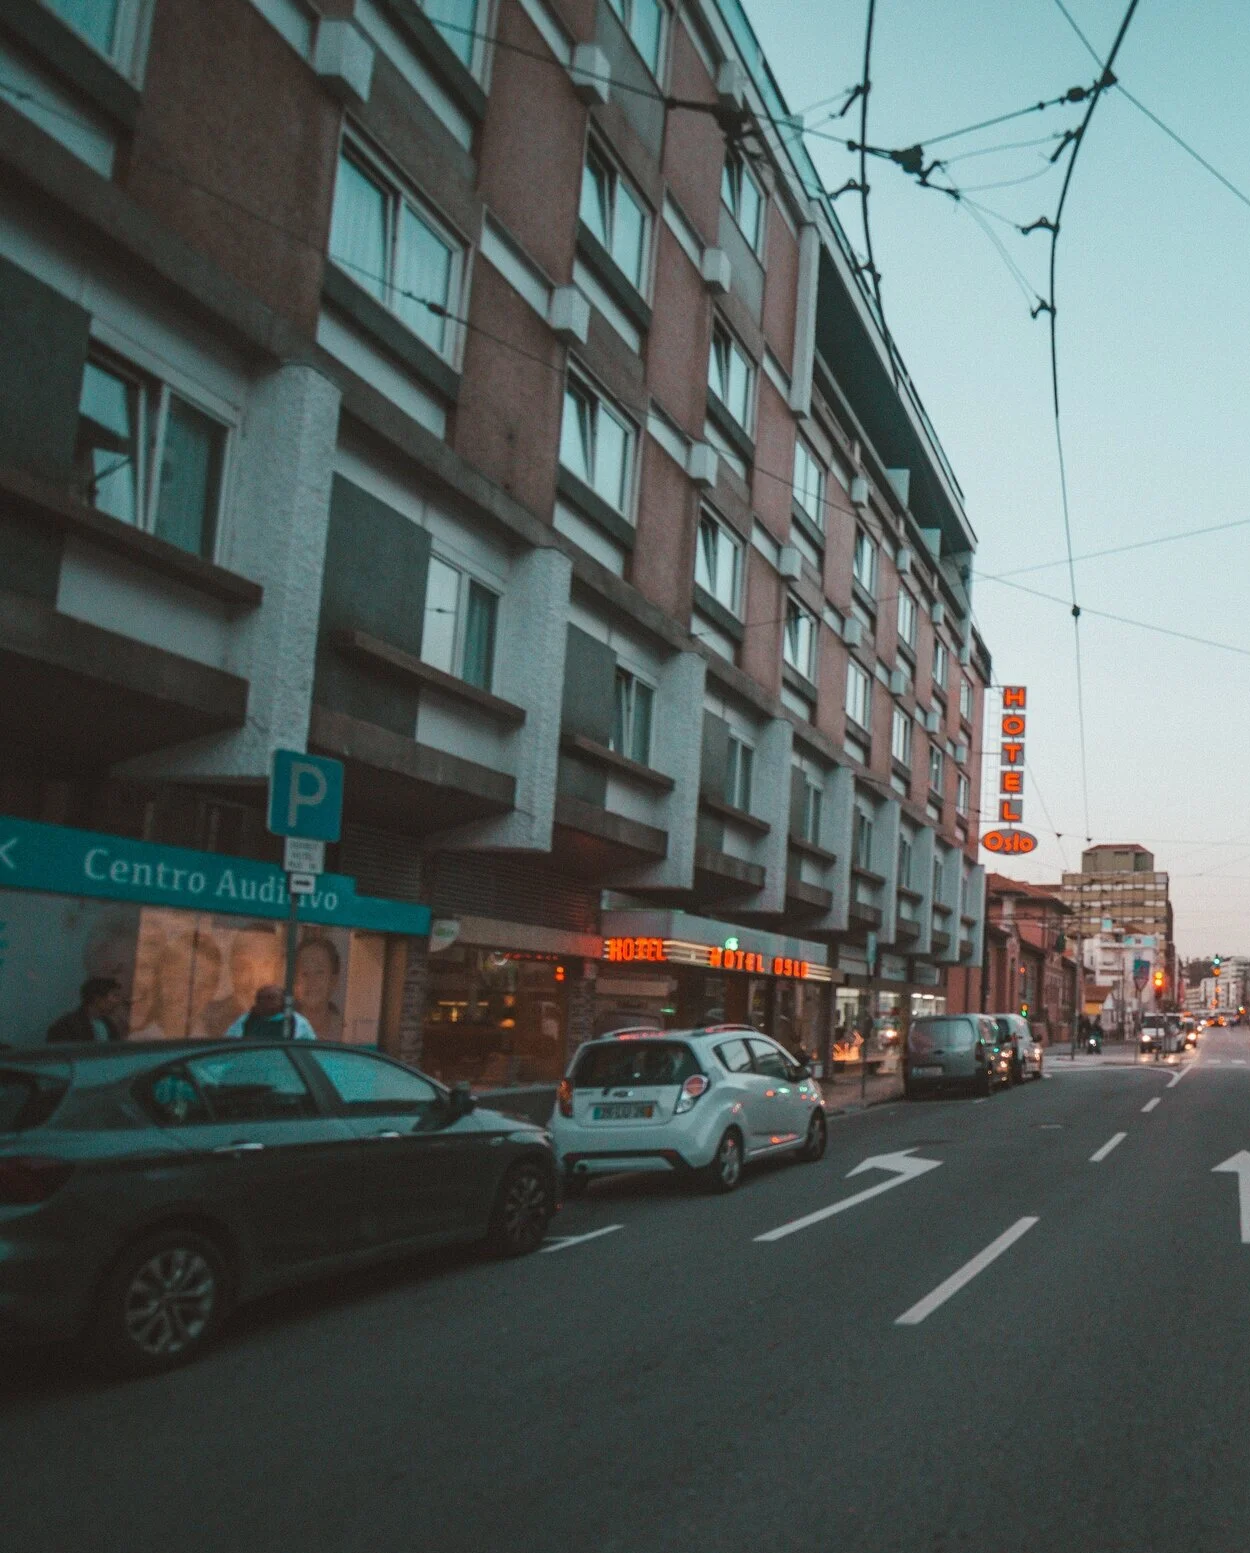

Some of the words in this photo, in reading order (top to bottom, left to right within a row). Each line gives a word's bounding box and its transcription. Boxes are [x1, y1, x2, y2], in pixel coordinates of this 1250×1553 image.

[1002, 687, 1025, 821] HOTEL
[288, 762, 328, 828] P
[984, 831, 1034, 853] Oslo
[84, 848, 206, 893] Centro
[215, 869, 338, 910] Audivo
[607, 938, 667, 962] HOTEL
[709, 947, 765, 973] HOTEL
[774, 957, 809, 978] OSLO
